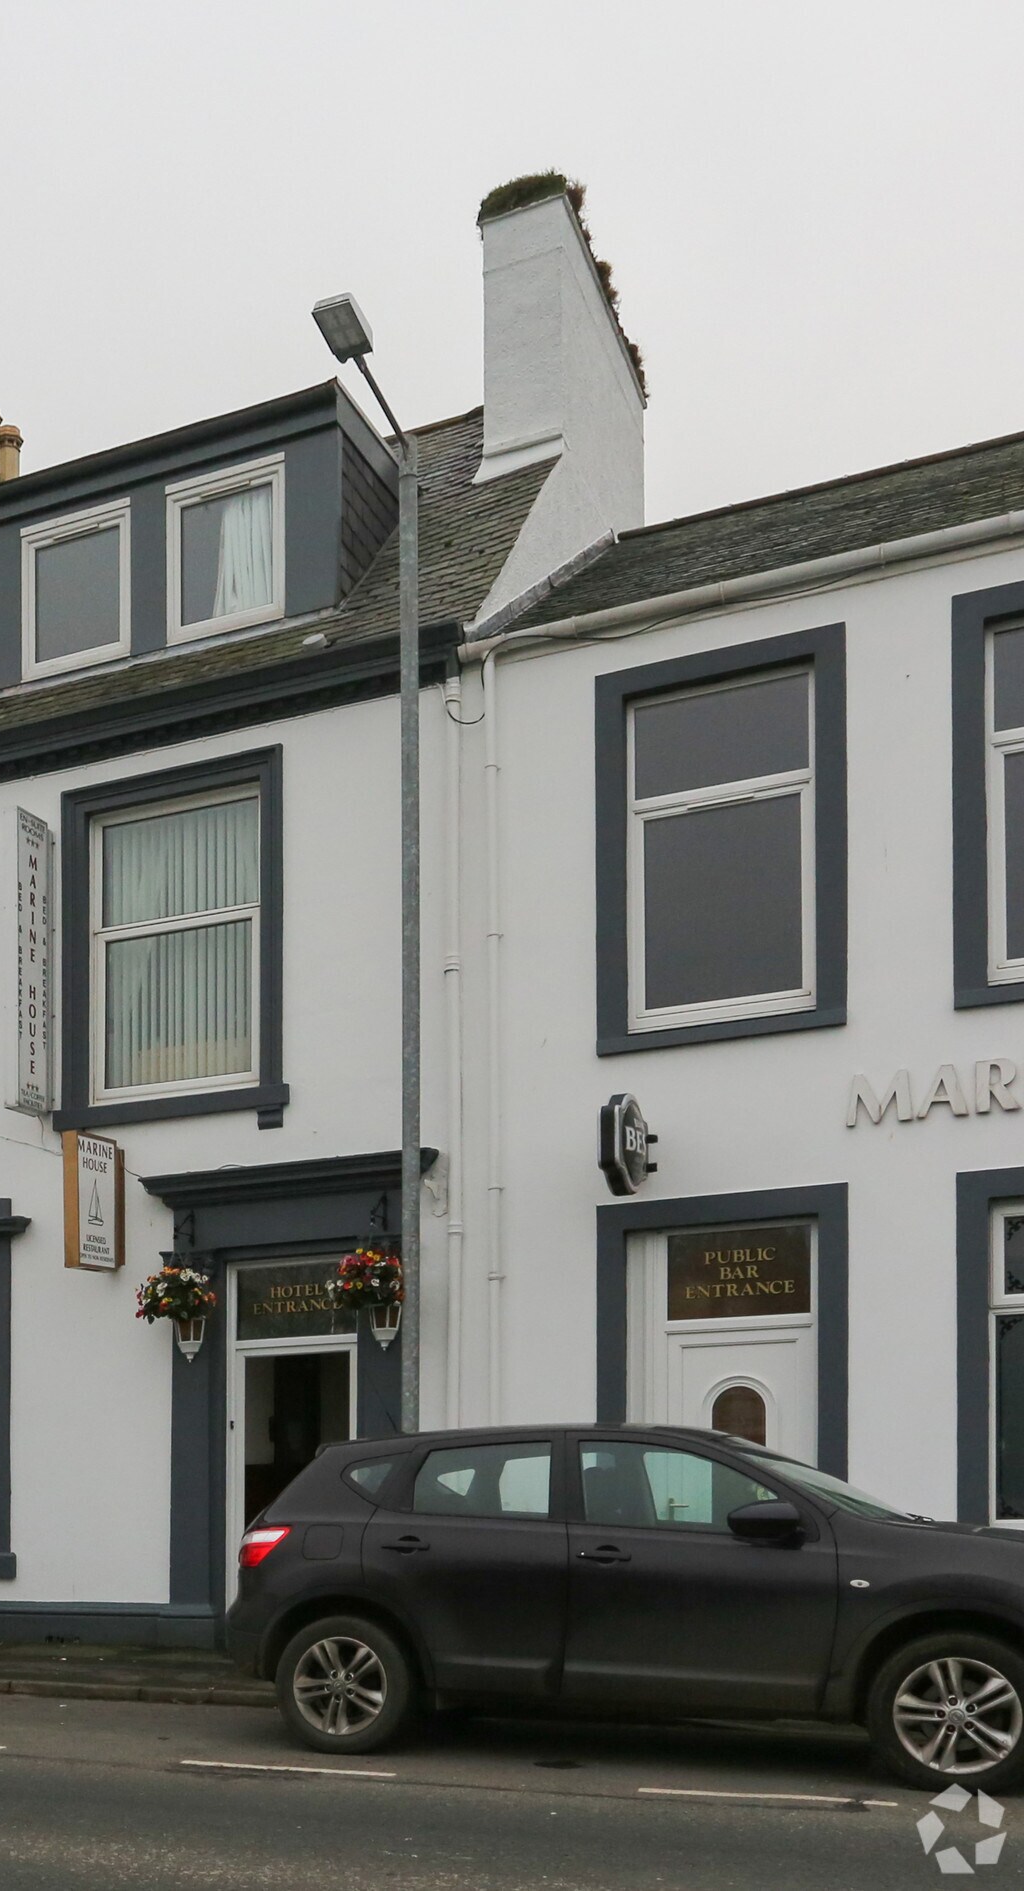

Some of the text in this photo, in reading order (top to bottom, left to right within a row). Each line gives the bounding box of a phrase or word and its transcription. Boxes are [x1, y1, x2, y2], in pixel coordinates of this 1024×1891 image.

[21, 824, 44, 842] ROOMS
[28, 854, 38, 1075] MARINE HOUSE
[78, 1139, 113, 1160] MARINE
[82, 1156, 108, 1174] HOUSE
[704, 1246, 776, 1265] PUBLIC
[719, 1264, 760, 1280] BAR
[270, 1283, 324, 1299] HOTEL
[685, 1279, 796, 1299] ENTRANCE
